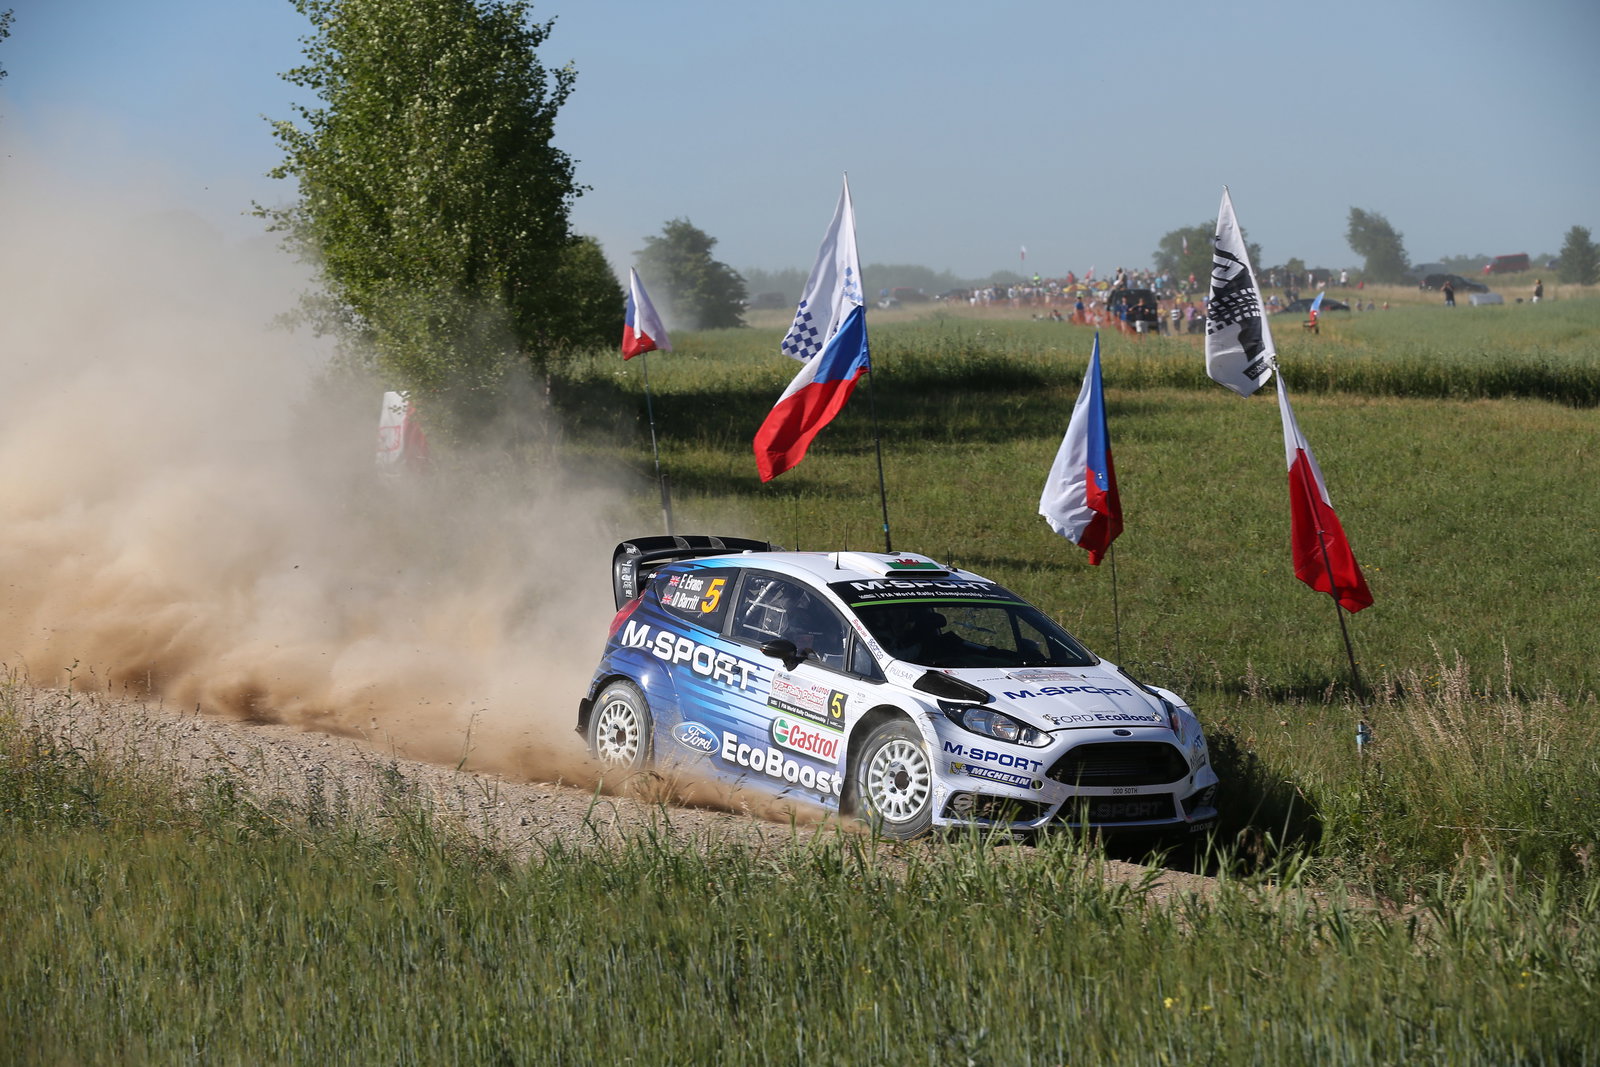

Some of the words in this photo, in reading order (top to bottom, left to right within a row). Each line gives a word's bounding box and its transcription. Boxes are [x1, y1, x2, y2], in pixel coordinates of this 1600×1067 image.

[678, 574, 688, 588] E
[684, 575, 704, 591] Evans
[850, 580, 991, 591] M-SPORT
[671, 591, 680, 606] D
[701, 578, 725, 613] 5
[1003, 686, 1133, 700] M-SPORT
[831, 693, 844, 718] 5
[1094, 714, 1157, 722] EcoBoos
[681, 725, 712, 751] Ford
[789, 724, 840, 760] Castrol
[721, 731, 842, 797] EcoBoost
[943, 741, 1043, 772] M-SPORT
[971, 767, 1030, 786] MICHELIN
